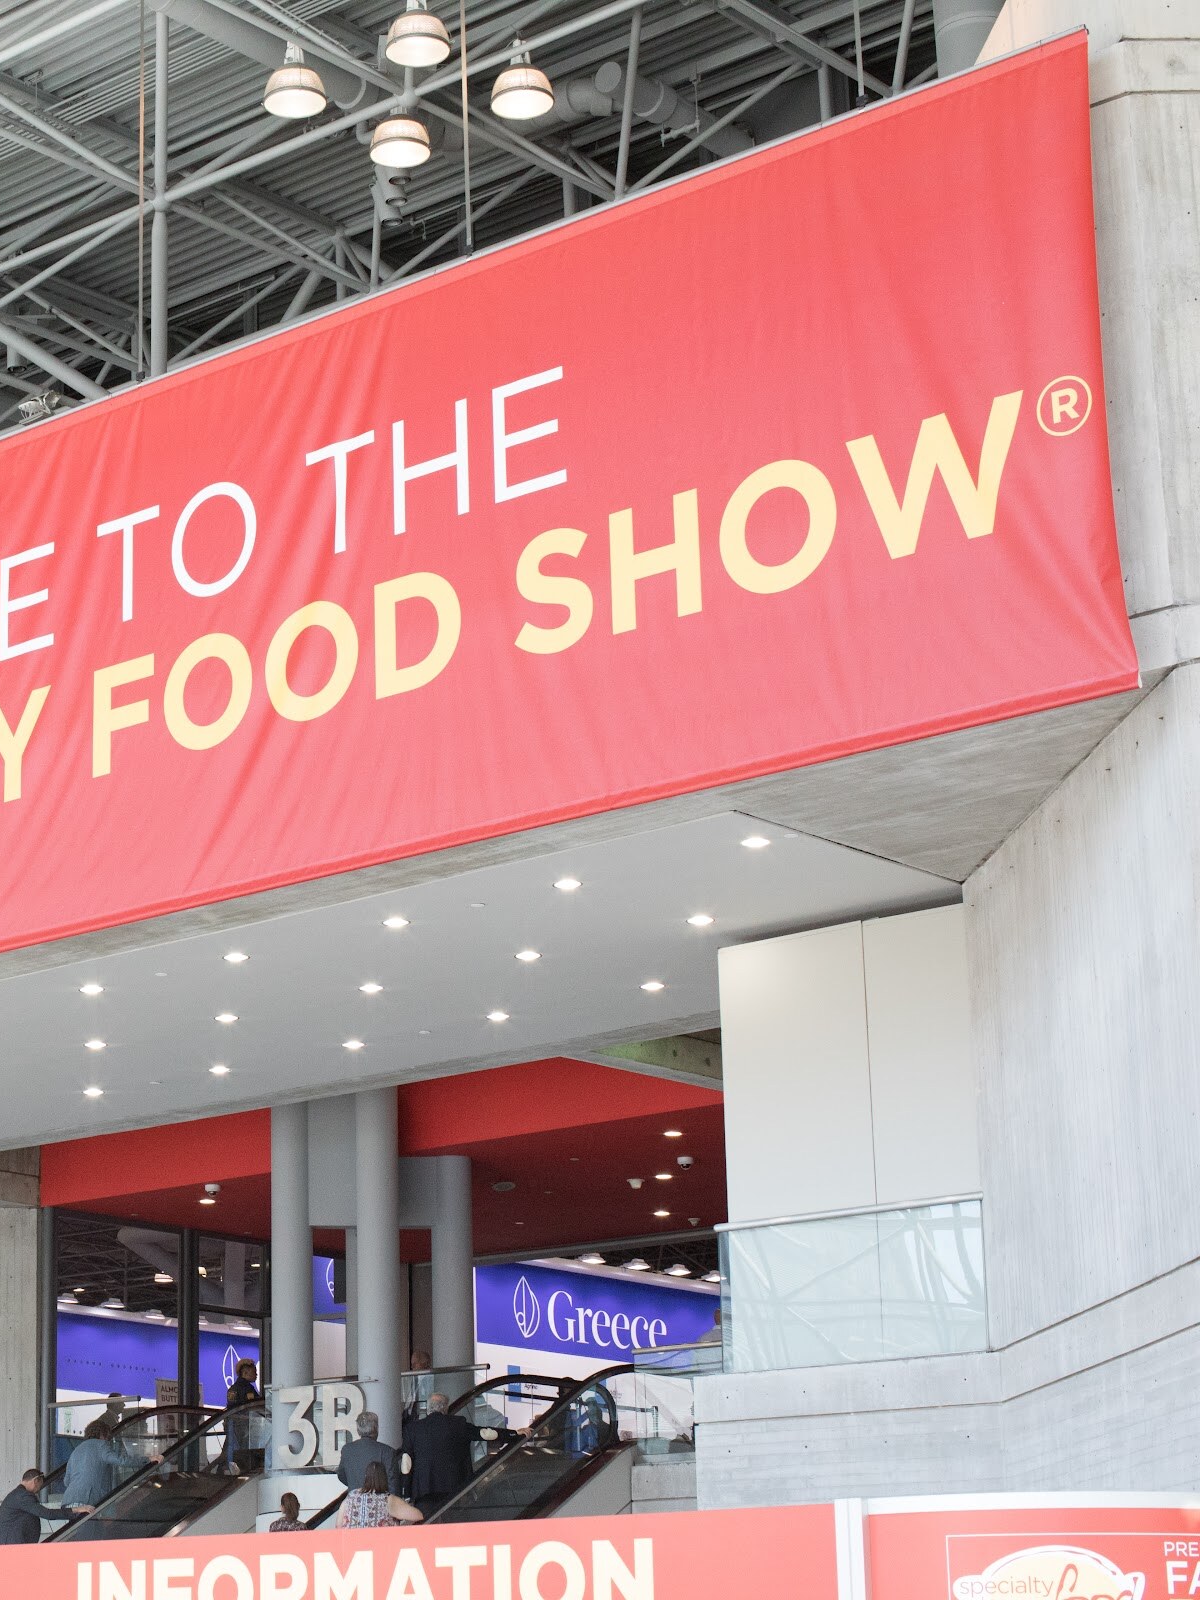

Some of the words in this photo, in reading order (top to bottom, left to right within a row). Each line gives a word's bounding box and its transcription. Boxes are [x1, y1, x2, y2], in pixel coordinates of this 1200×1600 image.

[97, 482, 257, 621] TO
[306, 366, 568, 553] THE
[93, 572, 461, 778] FOOD
[547, 1290, 667, 1348] Greece
[278, 1383, 365, 1469] 3B
[77, 1538, 655, 1600] INFORMATION
[959, 1575, 1055, 1597] specialty
